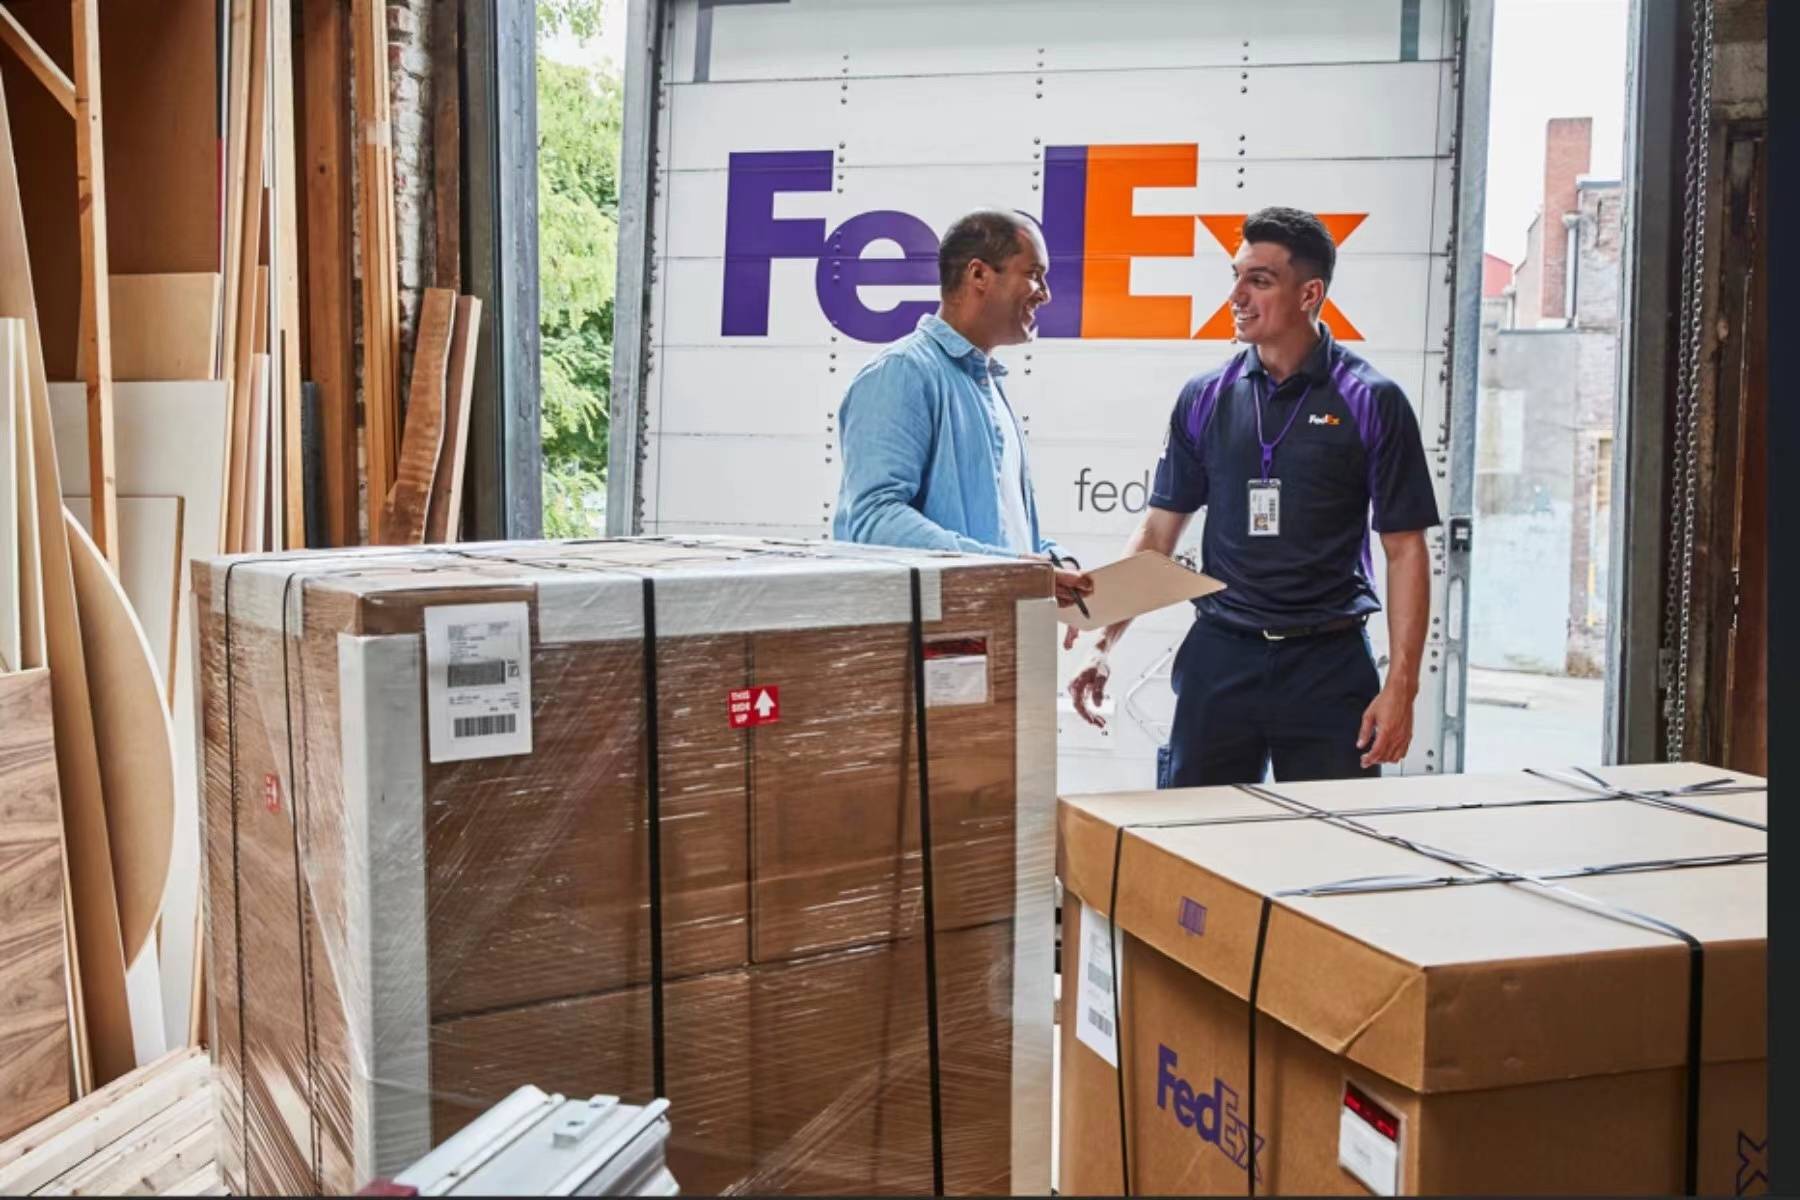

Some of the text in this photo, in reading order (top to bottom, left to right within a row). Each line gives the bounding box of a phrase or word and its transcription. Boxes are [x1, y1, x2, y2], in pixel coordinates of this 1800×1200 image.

[1308, 413, 1341, 425] FedEx
[731, 691, 750, 701] THIS
[732, 702, 750, 712] SIDE
[735, 713, 748, 723] UP
[1157, 1042, 1265, 1184] FedEx
